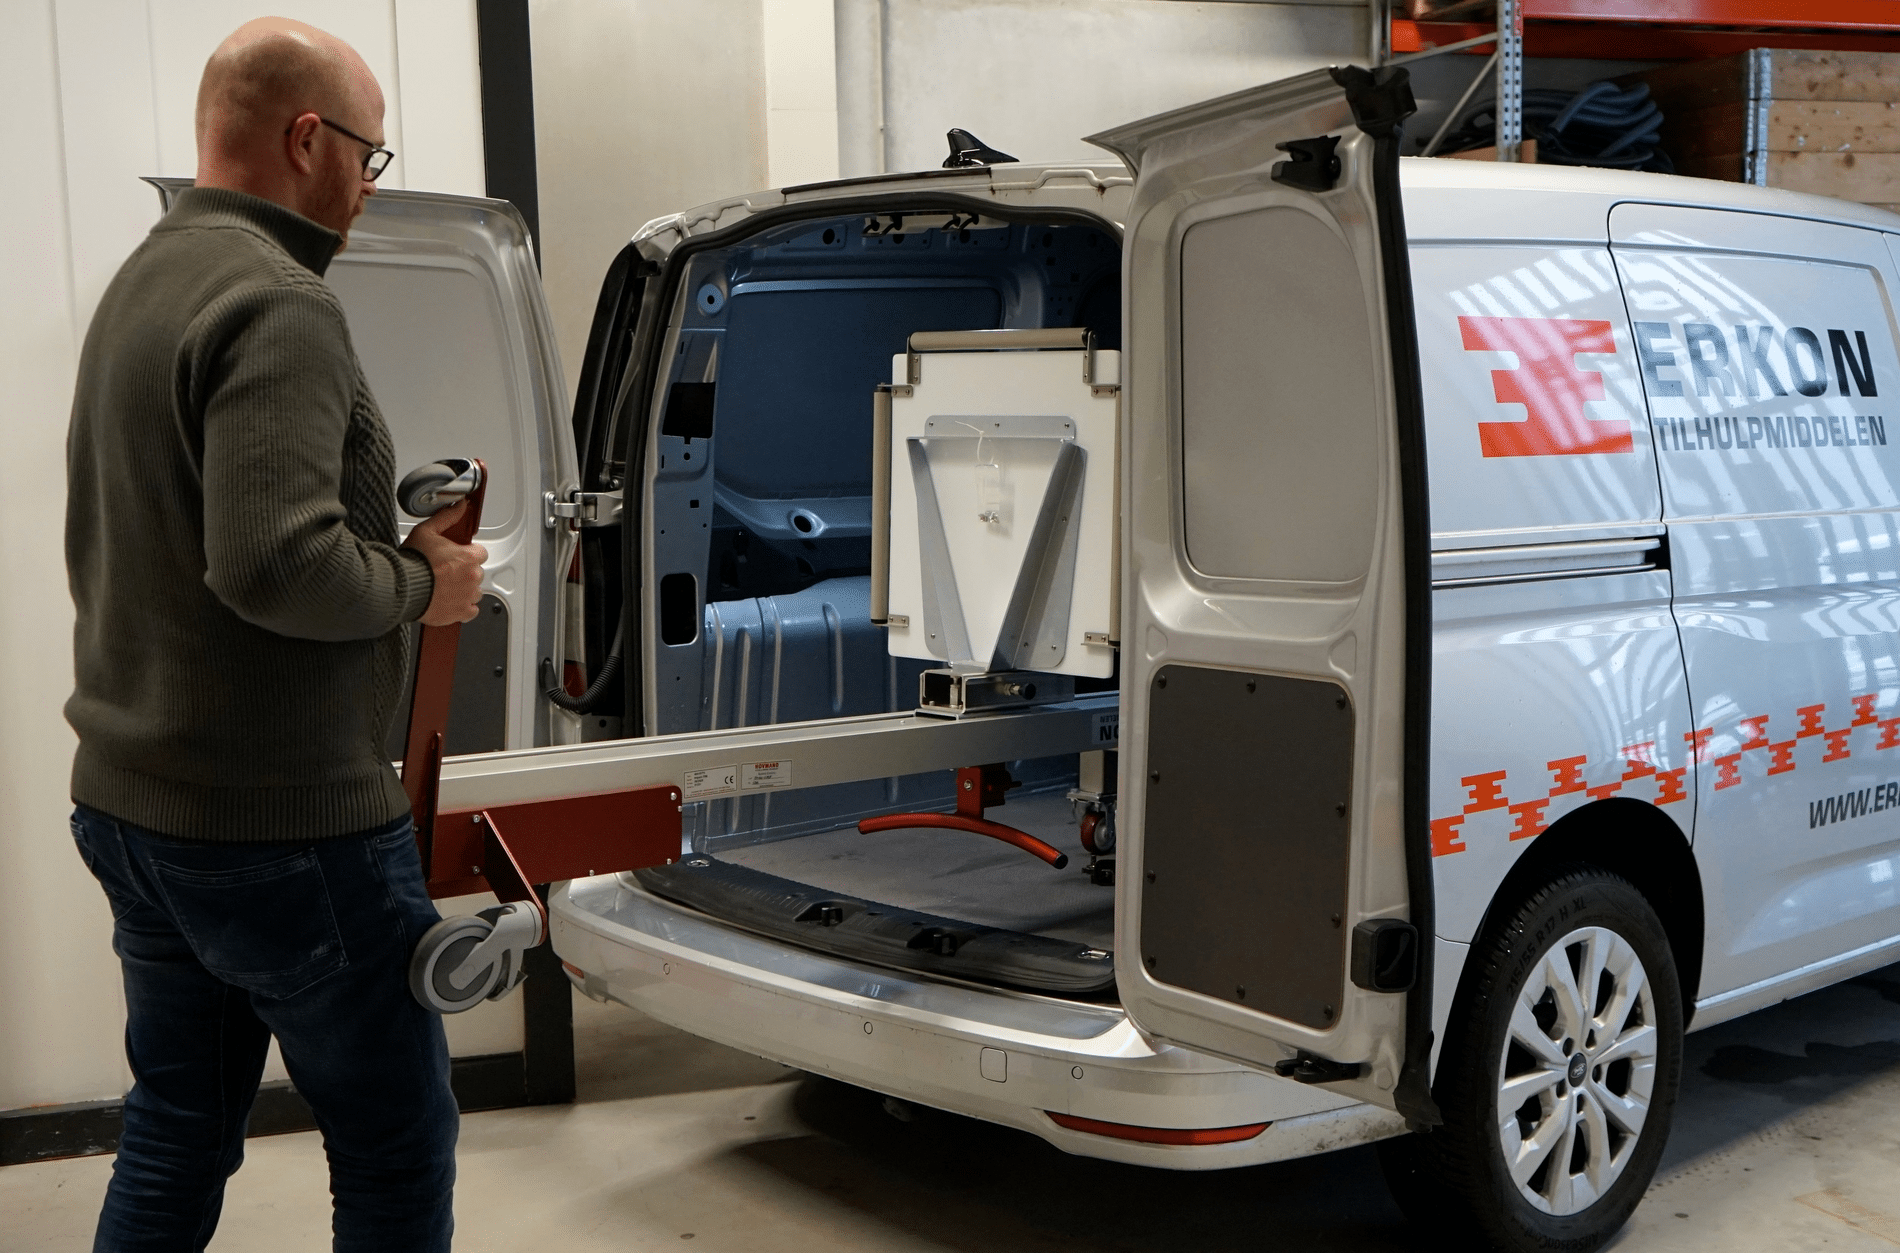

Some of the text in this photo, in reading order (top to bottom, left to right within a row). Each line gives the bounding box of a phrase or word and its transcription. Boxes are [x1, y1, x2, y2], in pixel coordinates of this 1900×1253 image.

[1633, 321, 1878, 397] ERKON
[1653, 415, 1888, 452] TILHULPMIDDELEN
[1809, 781, 1900, 829] WWW.ER
